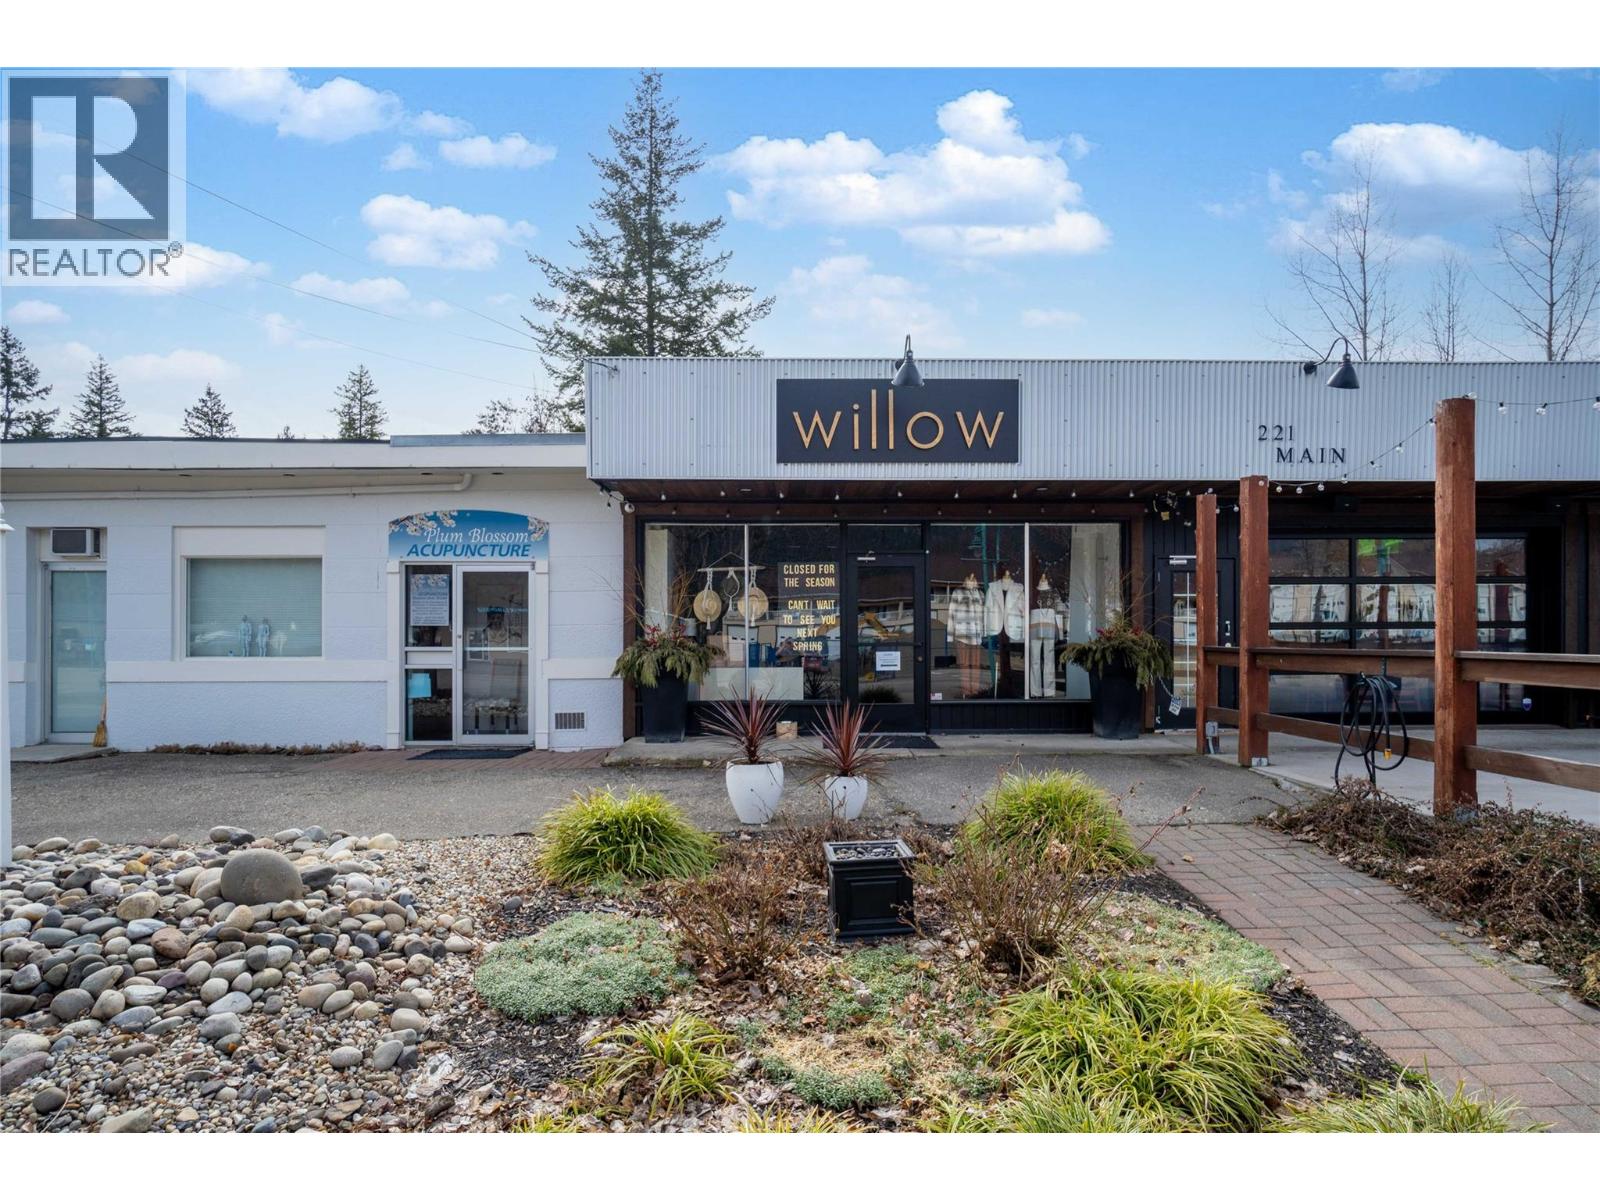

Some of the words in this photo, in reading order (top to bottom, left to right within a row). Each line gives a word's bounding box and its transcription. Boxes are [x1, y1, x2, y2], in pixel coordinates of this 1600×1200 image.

[793, 389, 1004, 450] willow
[1258, 424, 1293, 441] 221
[1276, 447, 1346, 463] MAIN
[424, 528, 463, 543] Plum
[468, 527, 528, 543] Blossom
[407, 545, 531, 557] ACUPUNCTURE
[783, 564, 816, 575] CLOSED
[819, 564, 835, 575] FOR
[784, 577, 799, 588] THE
[805, 577, 835, 588] SEASON
[816, 600, 835, 610] WAIT
[783, 614, 793, 625] TO
[800, 614, 815, 625] SEE
[821, 614, 836, 625] YOU
[797, 628, 817, 638] NEXT
[793, 641, 823, 652] SPRING
